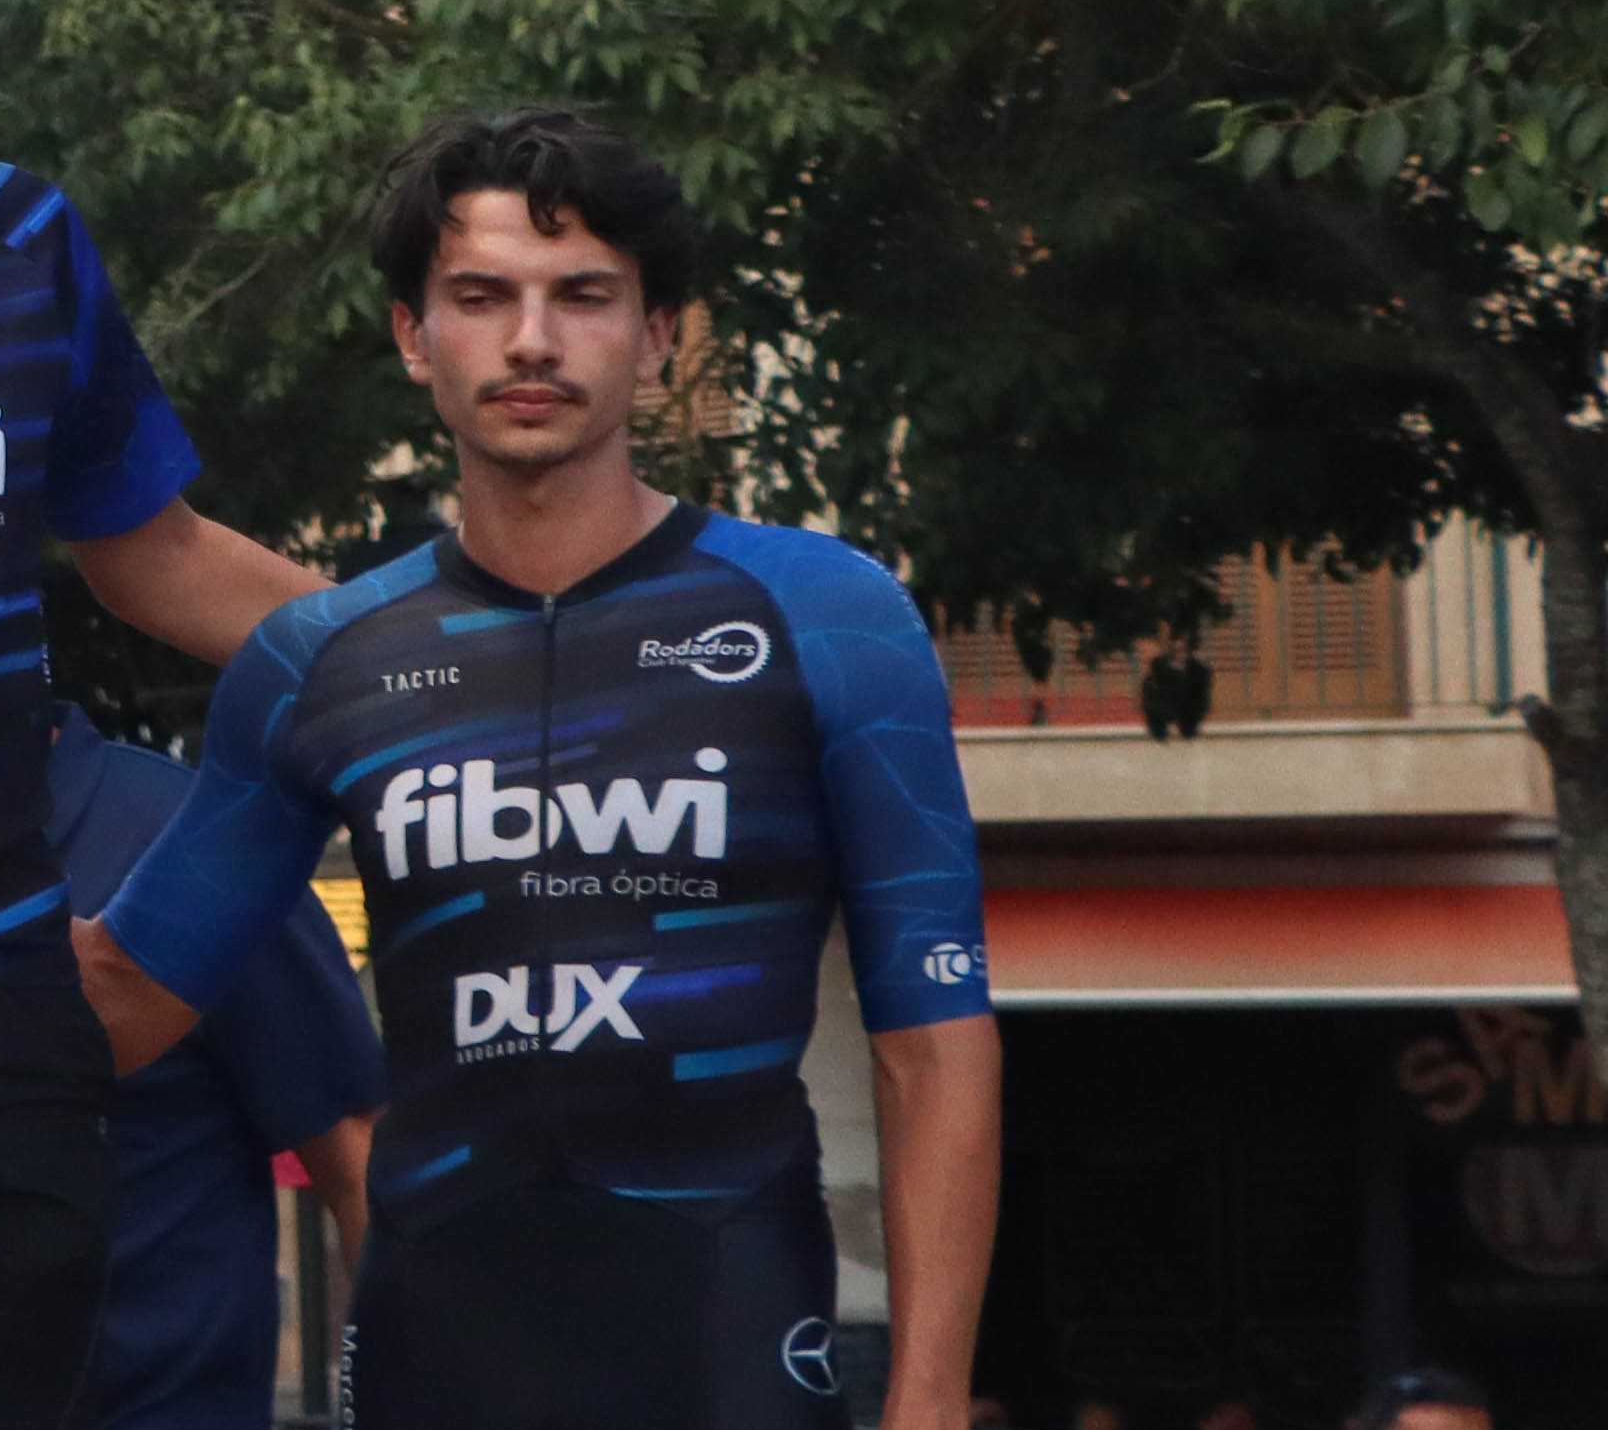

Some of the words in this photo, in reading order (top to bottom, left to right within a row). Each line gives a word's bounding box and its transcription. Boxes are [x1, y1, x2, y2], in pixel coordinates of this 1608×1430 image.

[640, 638, 757, 659] Rodadors
[382, 667, 461, 693] TACTIC
[375, 747, 728, 881] fibwi
[520, 871, 602, 898] fibra
[611, 868, 720, 902] óptica
[455, 963, 645, 1054] DUX
